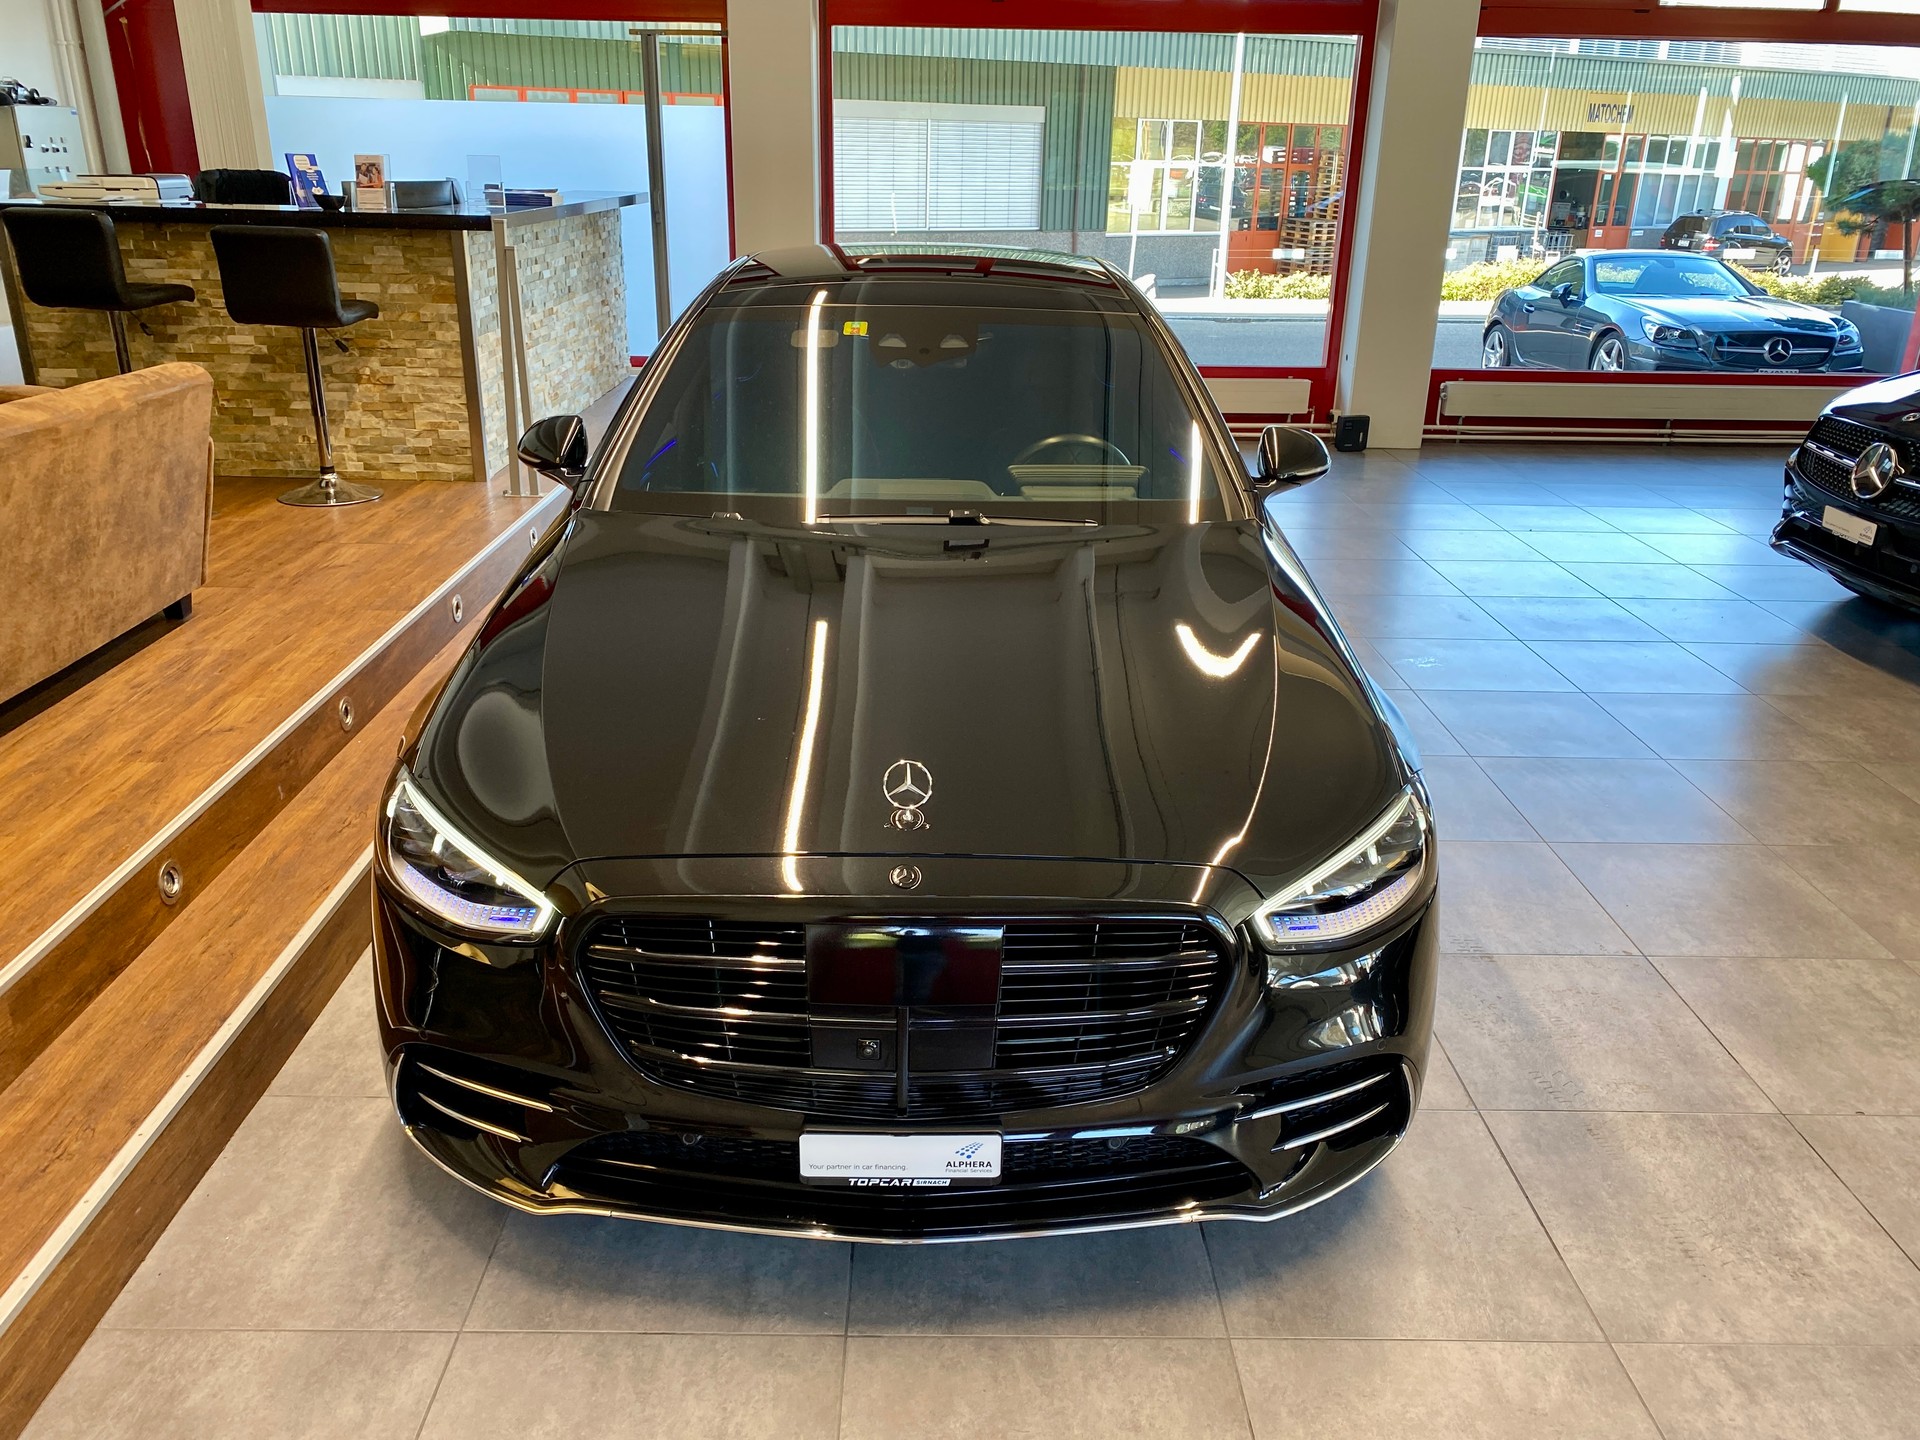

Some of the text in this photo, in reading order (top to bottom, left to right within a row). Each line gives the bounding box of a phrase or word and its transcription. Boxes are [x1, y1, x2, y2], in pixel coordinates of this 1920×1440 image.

[1587, 103, 1635, 124] MATOCHEM
[826, 1163, 852, 1172] partner
[861, 1163, 873, 1171] car
[874, 1163, 909, 1172] financing.
[848, 1178, 913, 1187] TOPCAR
